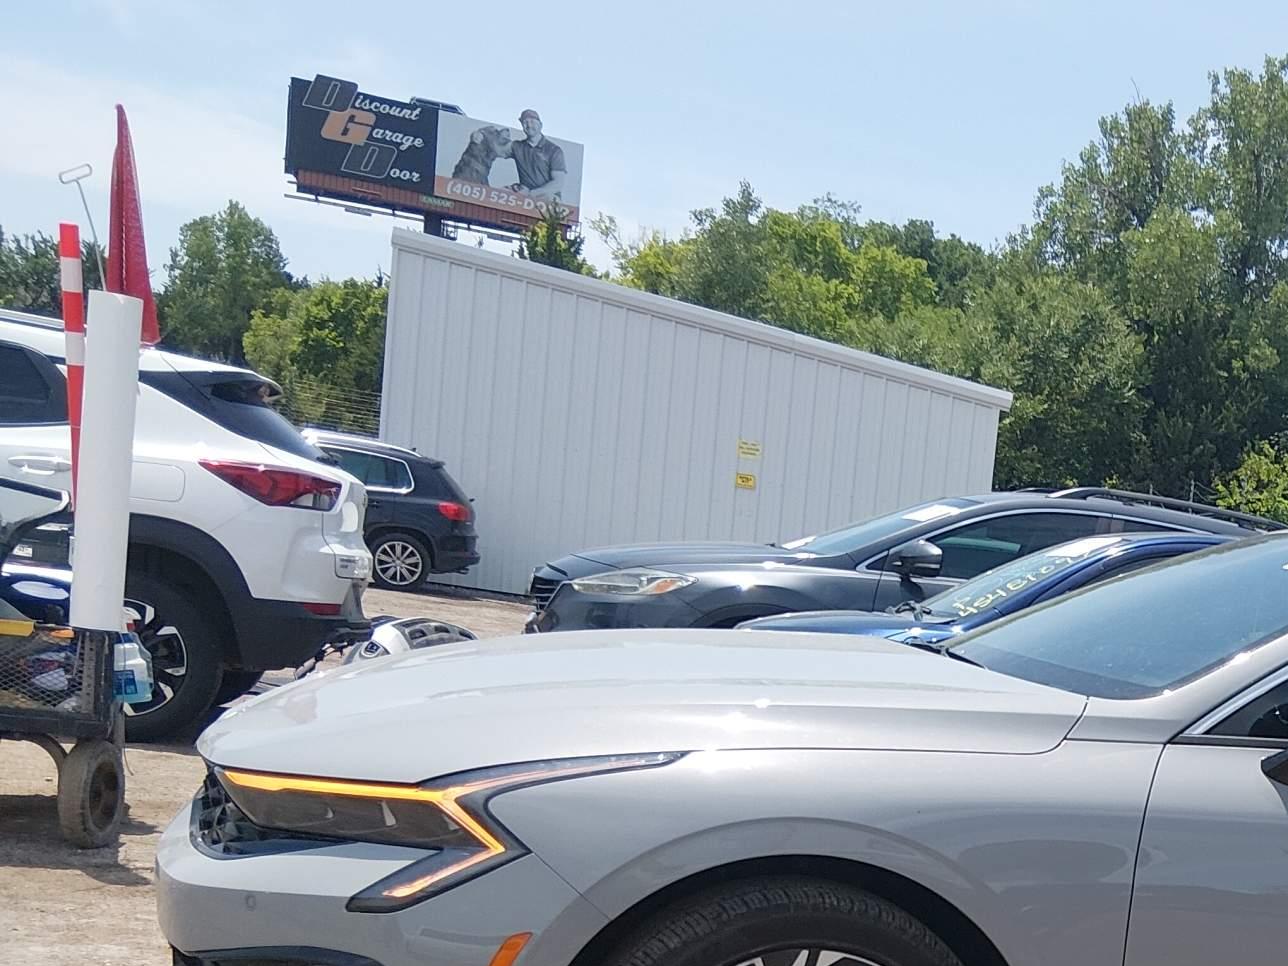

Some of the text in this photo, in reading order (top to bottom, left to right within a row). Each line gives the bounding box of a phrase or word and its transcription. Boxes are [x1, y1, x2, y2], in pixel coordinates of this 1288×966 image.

[302, 74, 421, 121] Discount
[321, 107, 425, 151] Garage
[341, 140, 421, 183] Door
[446, 180, 486, 201] (405)
